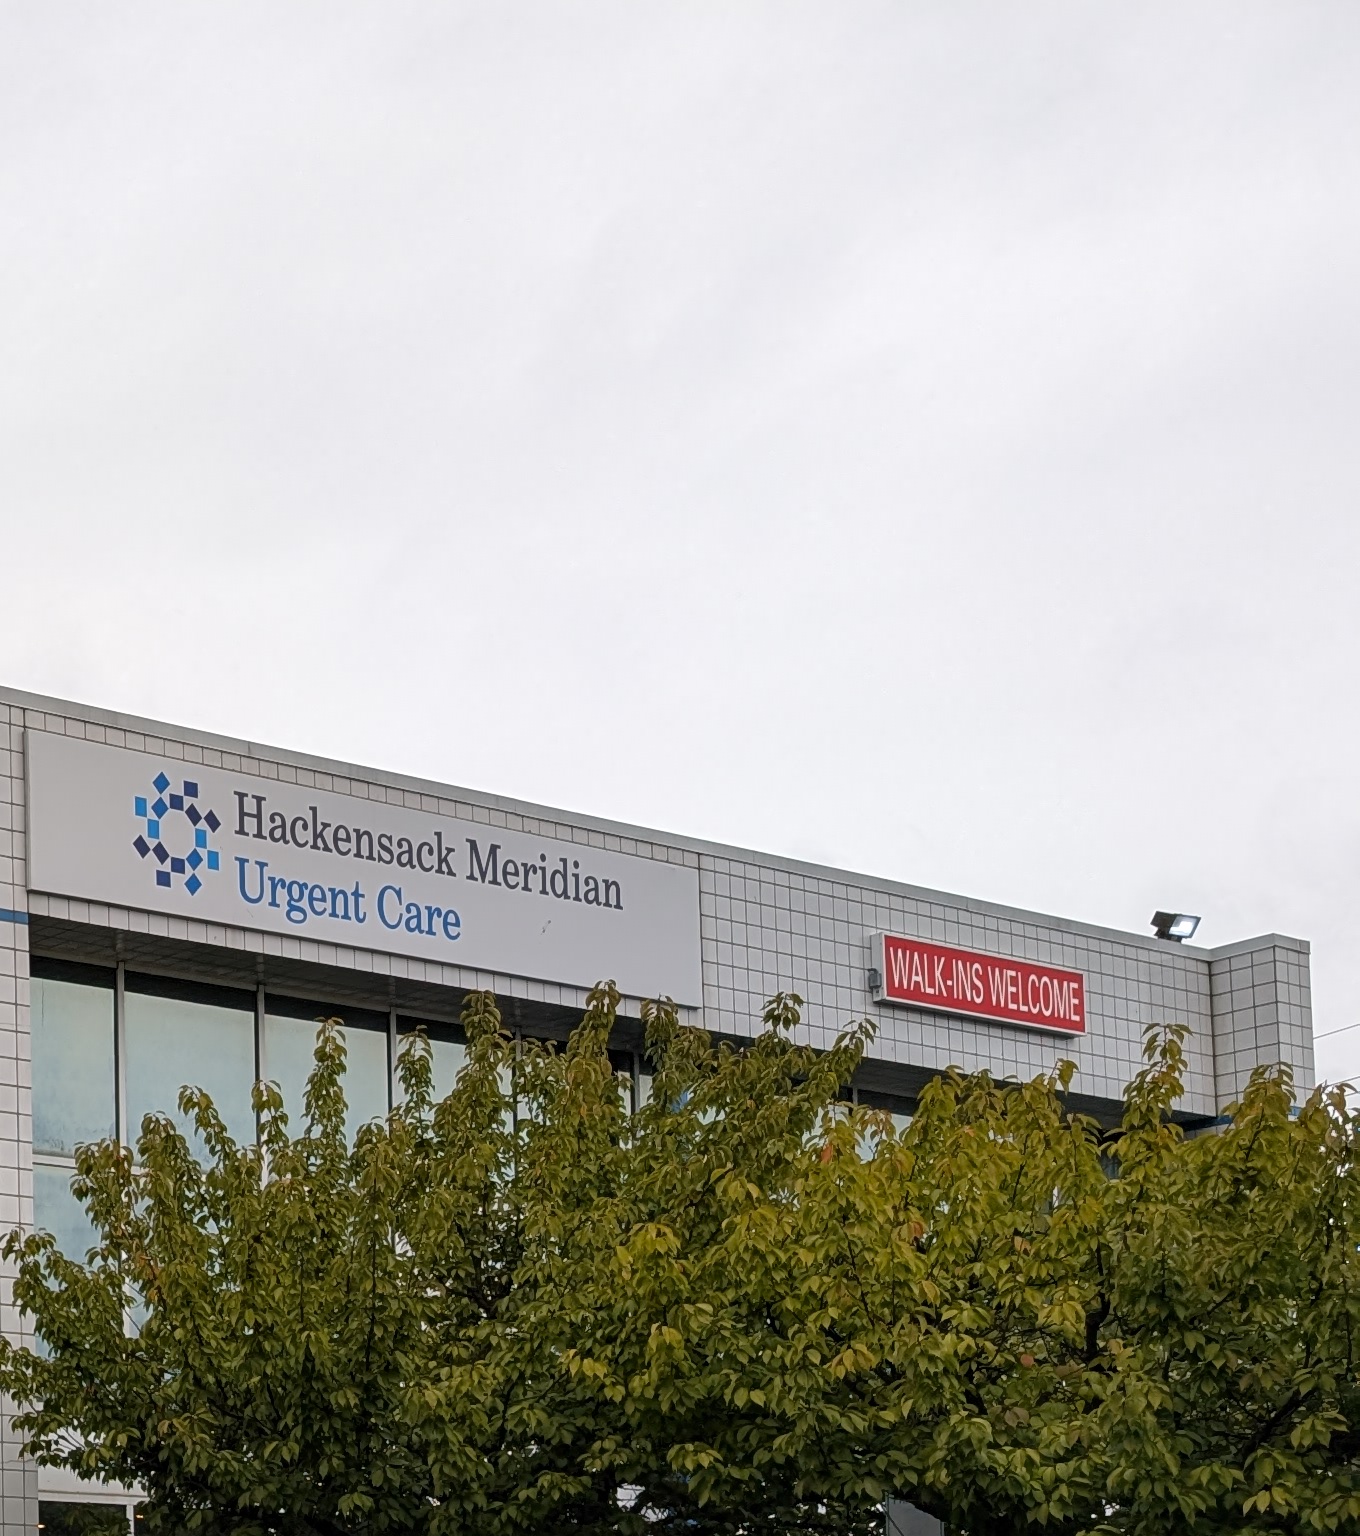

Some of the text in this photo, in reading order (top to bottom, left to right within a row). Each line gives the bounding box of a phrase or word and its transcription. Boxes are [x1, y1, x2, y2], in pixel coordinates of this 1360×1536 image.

[233, 790, 623, 910] Hackensack Meridian
[234, 856, 461, 941] Urgent Care
[890, 947, 1080, 1021] WALK-INS WELCOME
